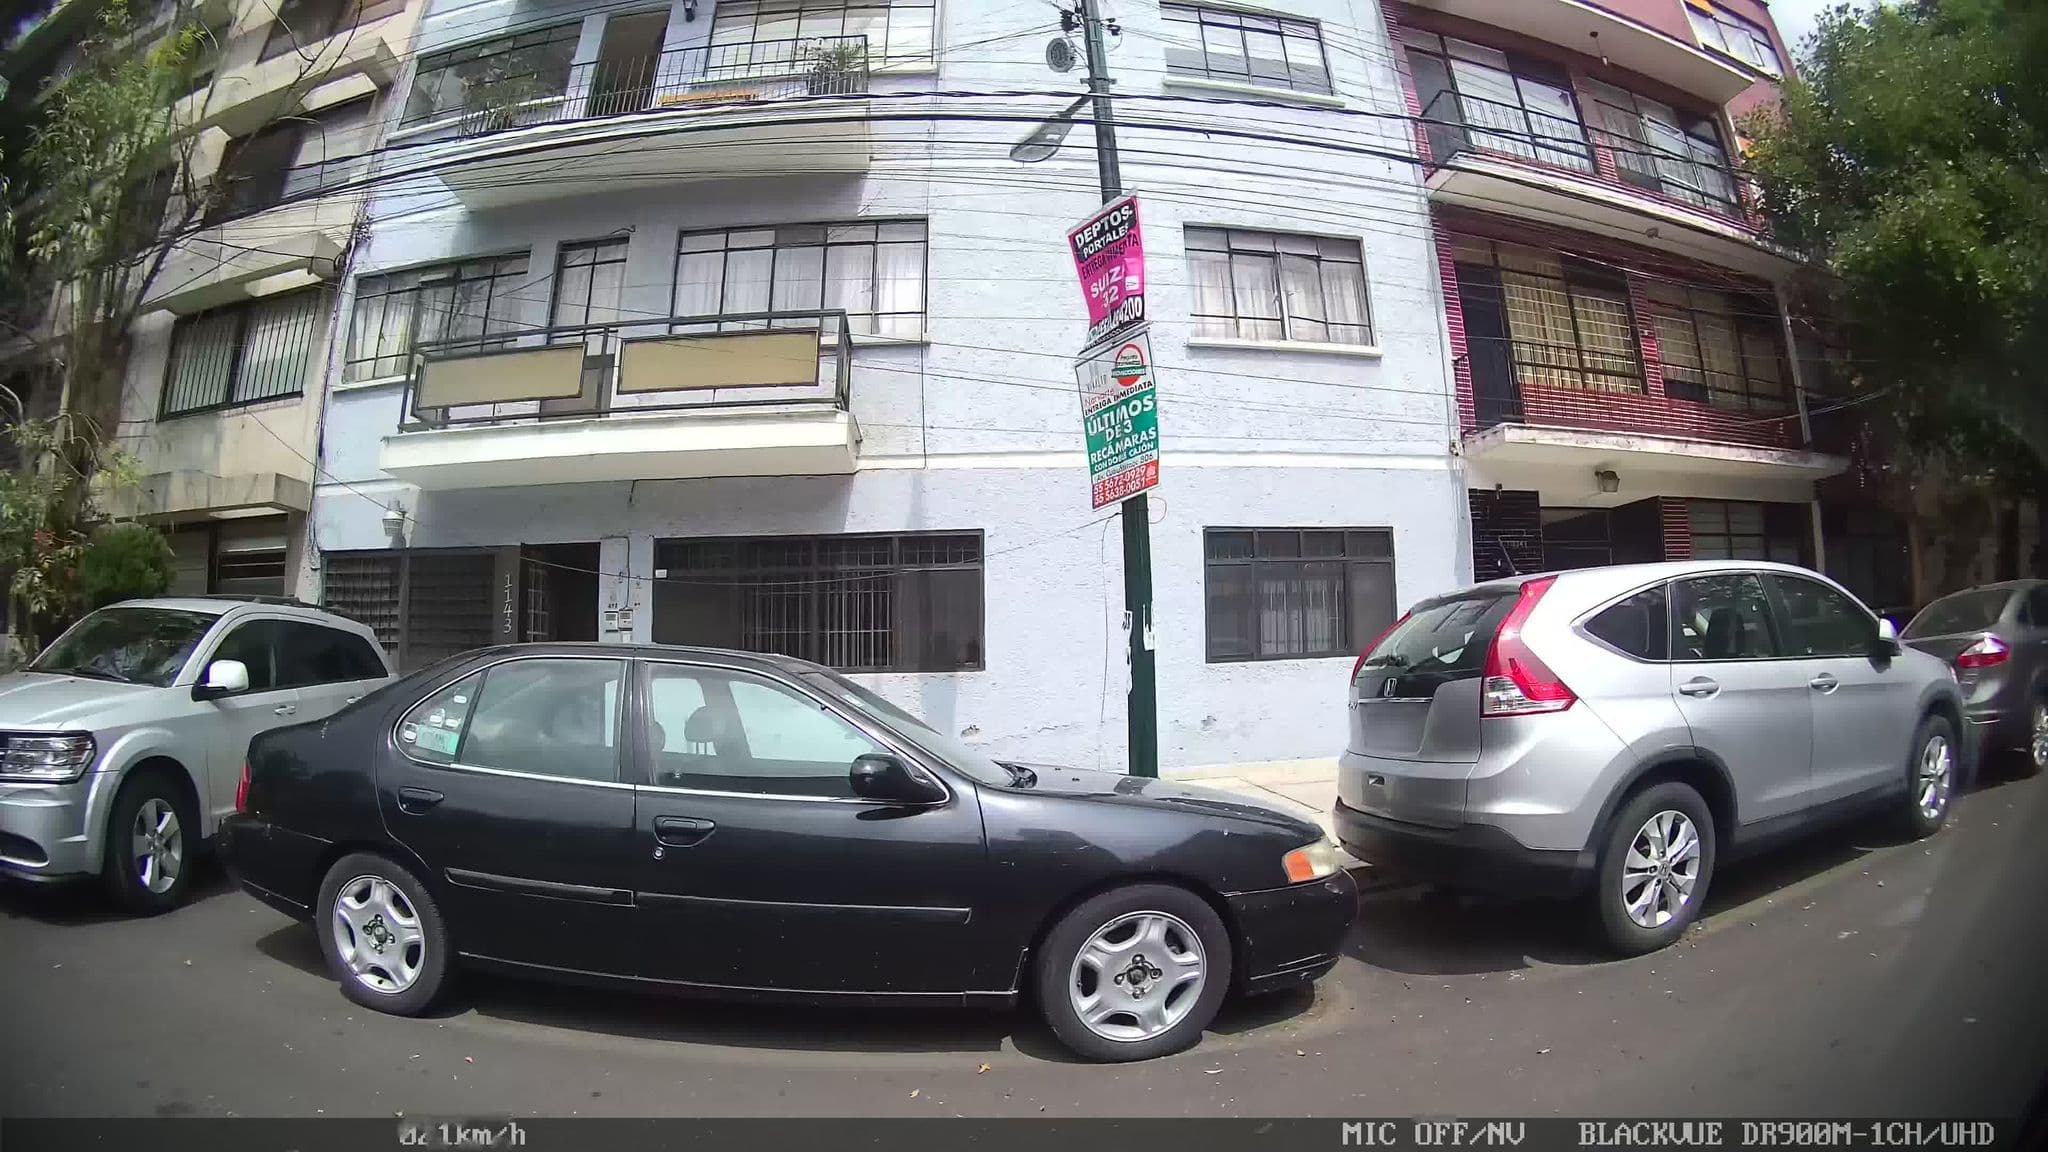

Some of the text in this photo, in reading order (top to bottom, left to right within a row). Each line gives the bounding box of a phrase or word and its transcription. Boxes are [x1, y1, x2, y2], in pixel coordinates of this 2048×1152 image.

[1074, 204, 1133, 249] DEPTOS.
[1102, 285, 1119, 308] 32
[1084, 399, 1112, 416] ENTREGA
[1113, 380, 1153, 402] INMEDIATA
[1087, 394, 1155, 437] ÚLTIMOS
[1105, 419, 1132, 442] DE 3
[1090, 426, 1157, 466] RECÁMARAS
[1094, 460, 1107, 472] CON
[1129, 441, 1154, 457] CAJÓN
[1094, 482, 1104, 494] 55
[1094, 494, 1104, 505] 55
[503, 574, 512, 634] 1143
